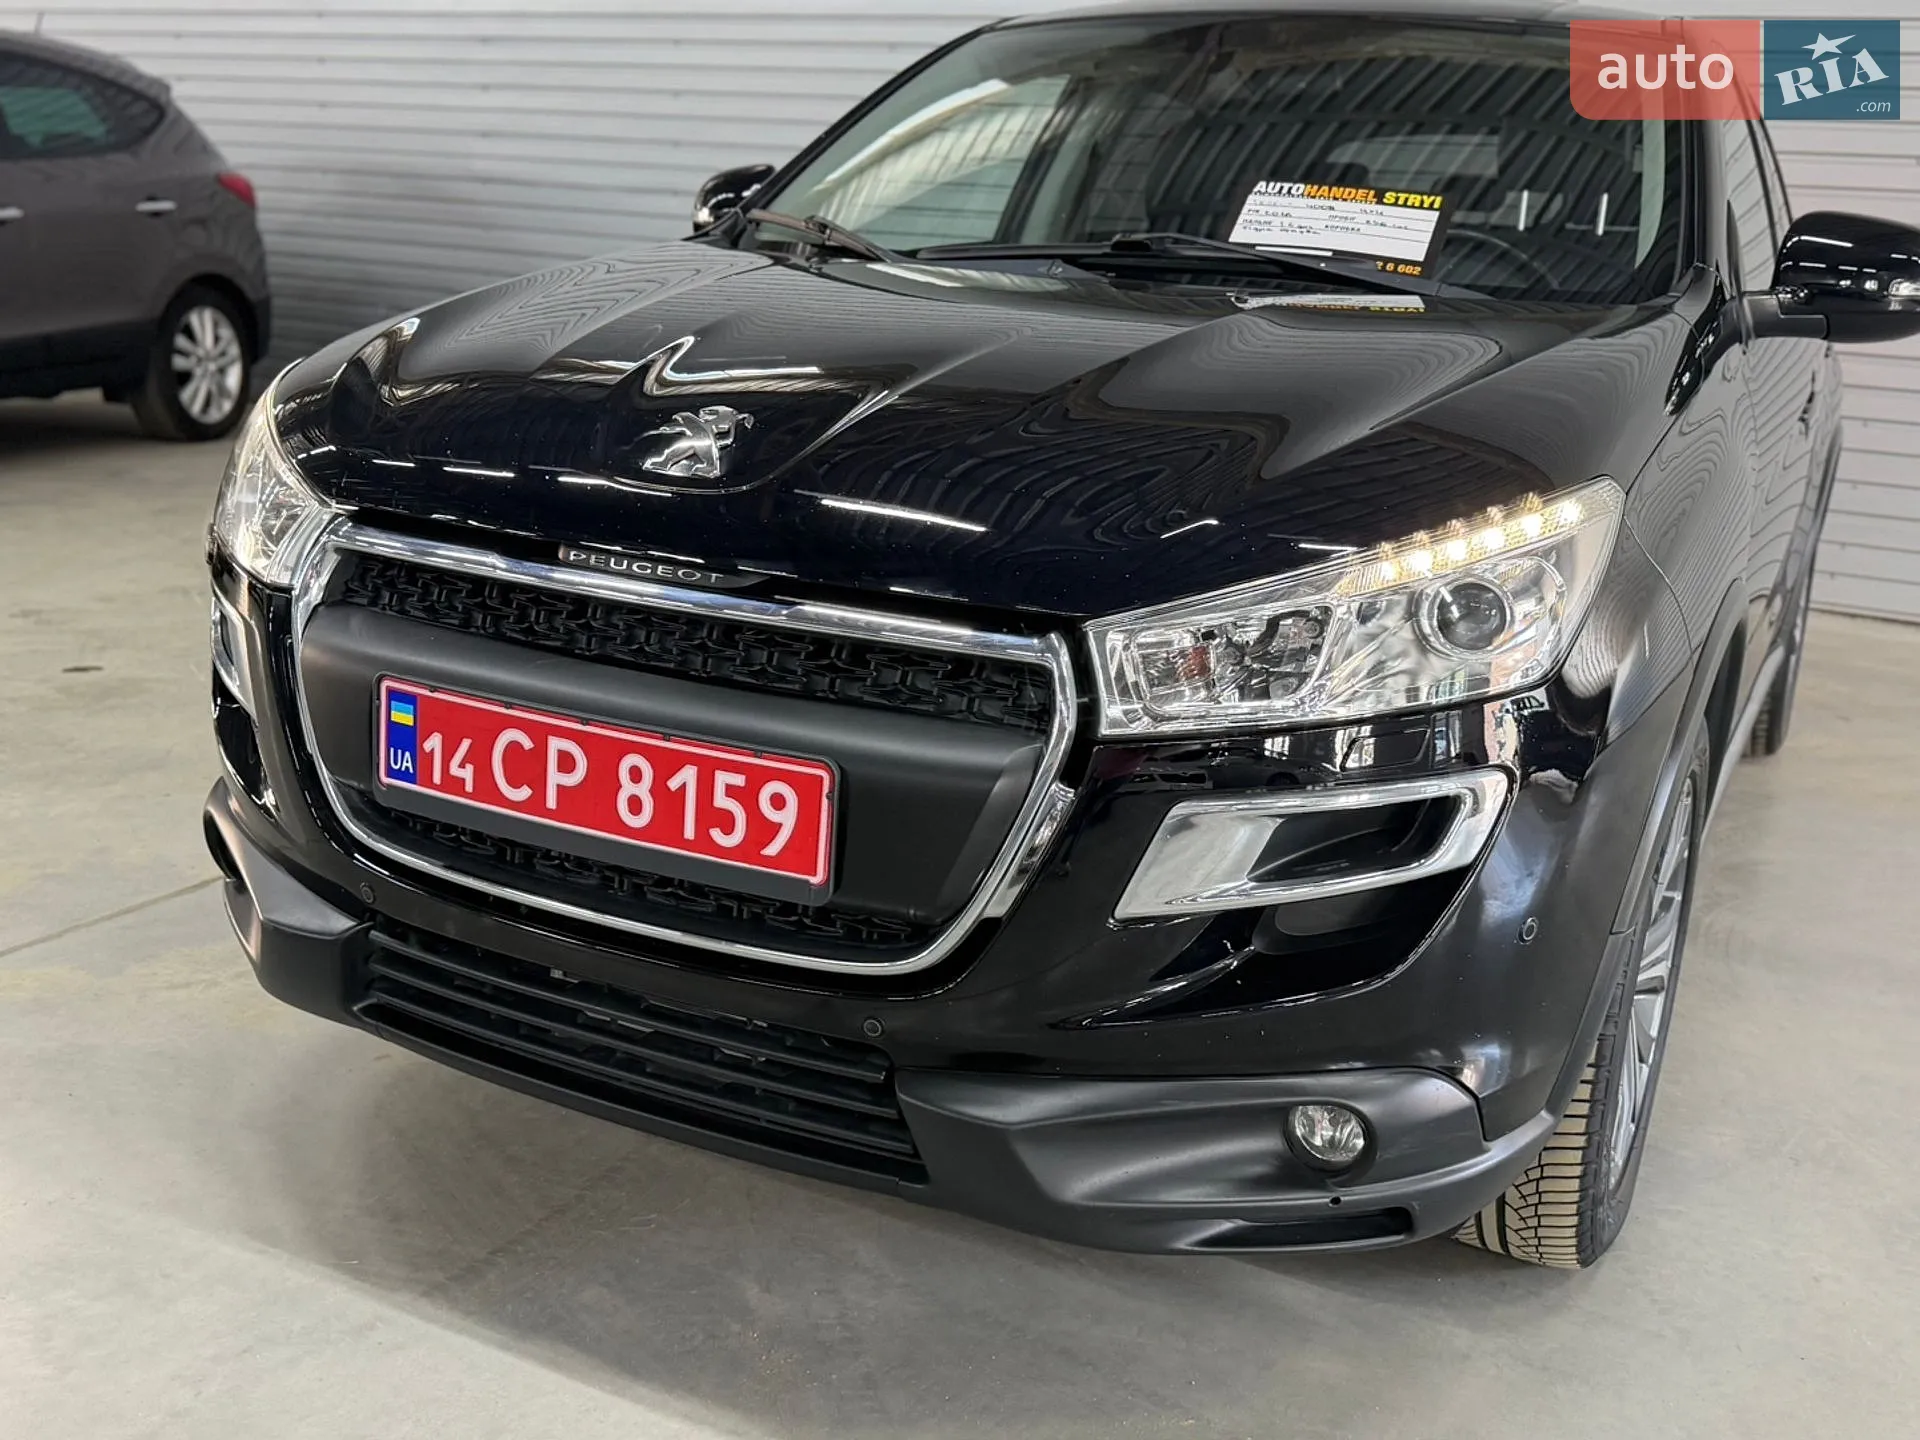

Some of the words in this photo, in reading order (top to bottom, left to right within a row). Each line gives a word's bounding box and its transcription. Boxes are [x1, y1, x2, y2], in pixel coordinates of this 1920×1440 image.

[1253, 181, 1377, 201] AUTOHANDEL
[1382, 191, 1444, 209] STRYI
[569, 550, 725, 584] PEUGEOT
[389, 747, 414, 774] UA
[422, 732, 474, 793] 14
[491, 728, 587, 810] CP
[615, 752, 799, 857] 8159
